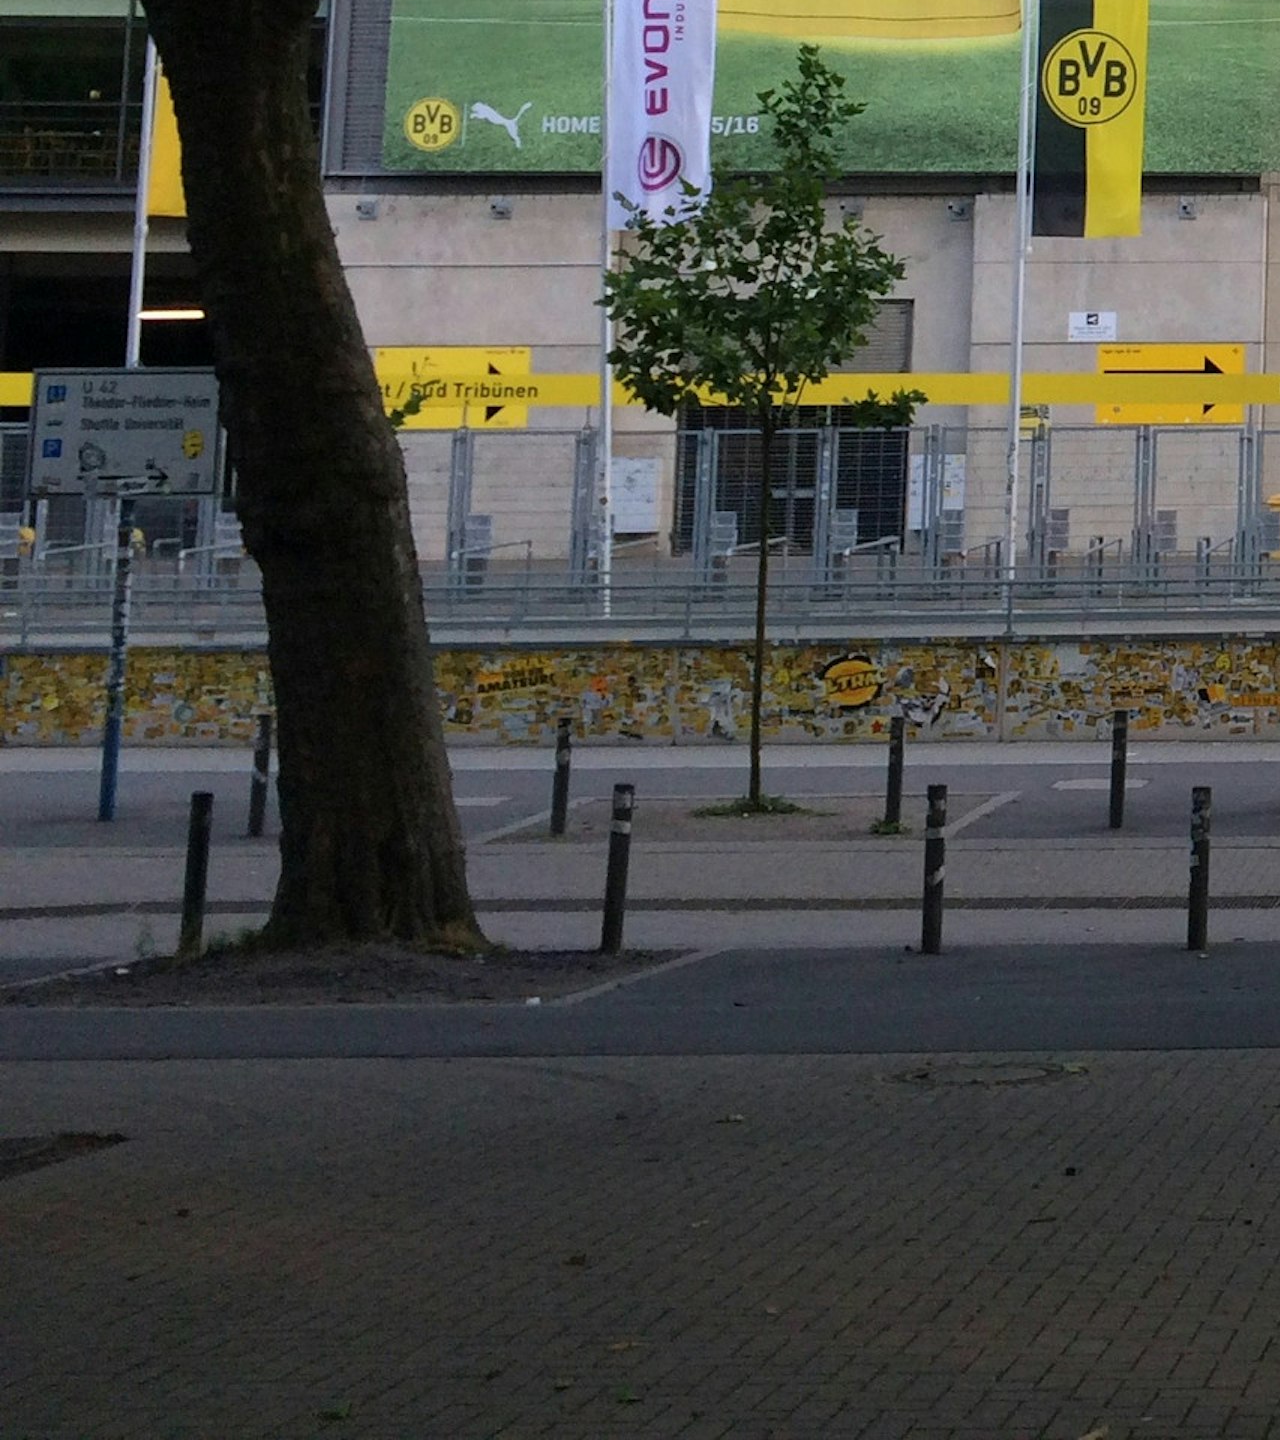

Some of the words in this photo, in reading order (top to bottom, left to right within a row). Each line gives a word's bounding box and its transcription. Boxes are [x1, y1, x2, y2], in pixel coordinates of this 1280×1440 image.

[1058, 40, 1128, 98] BVB
[1078, 96, 1101, 116] 09
[413, 104, 453, 134] BVB
[542, 116, 601, 135] HOME
[82, 381, 93, 393] U
[99, 381, 118, 393] 42
[453, 381, 539, 399] Tribünen
